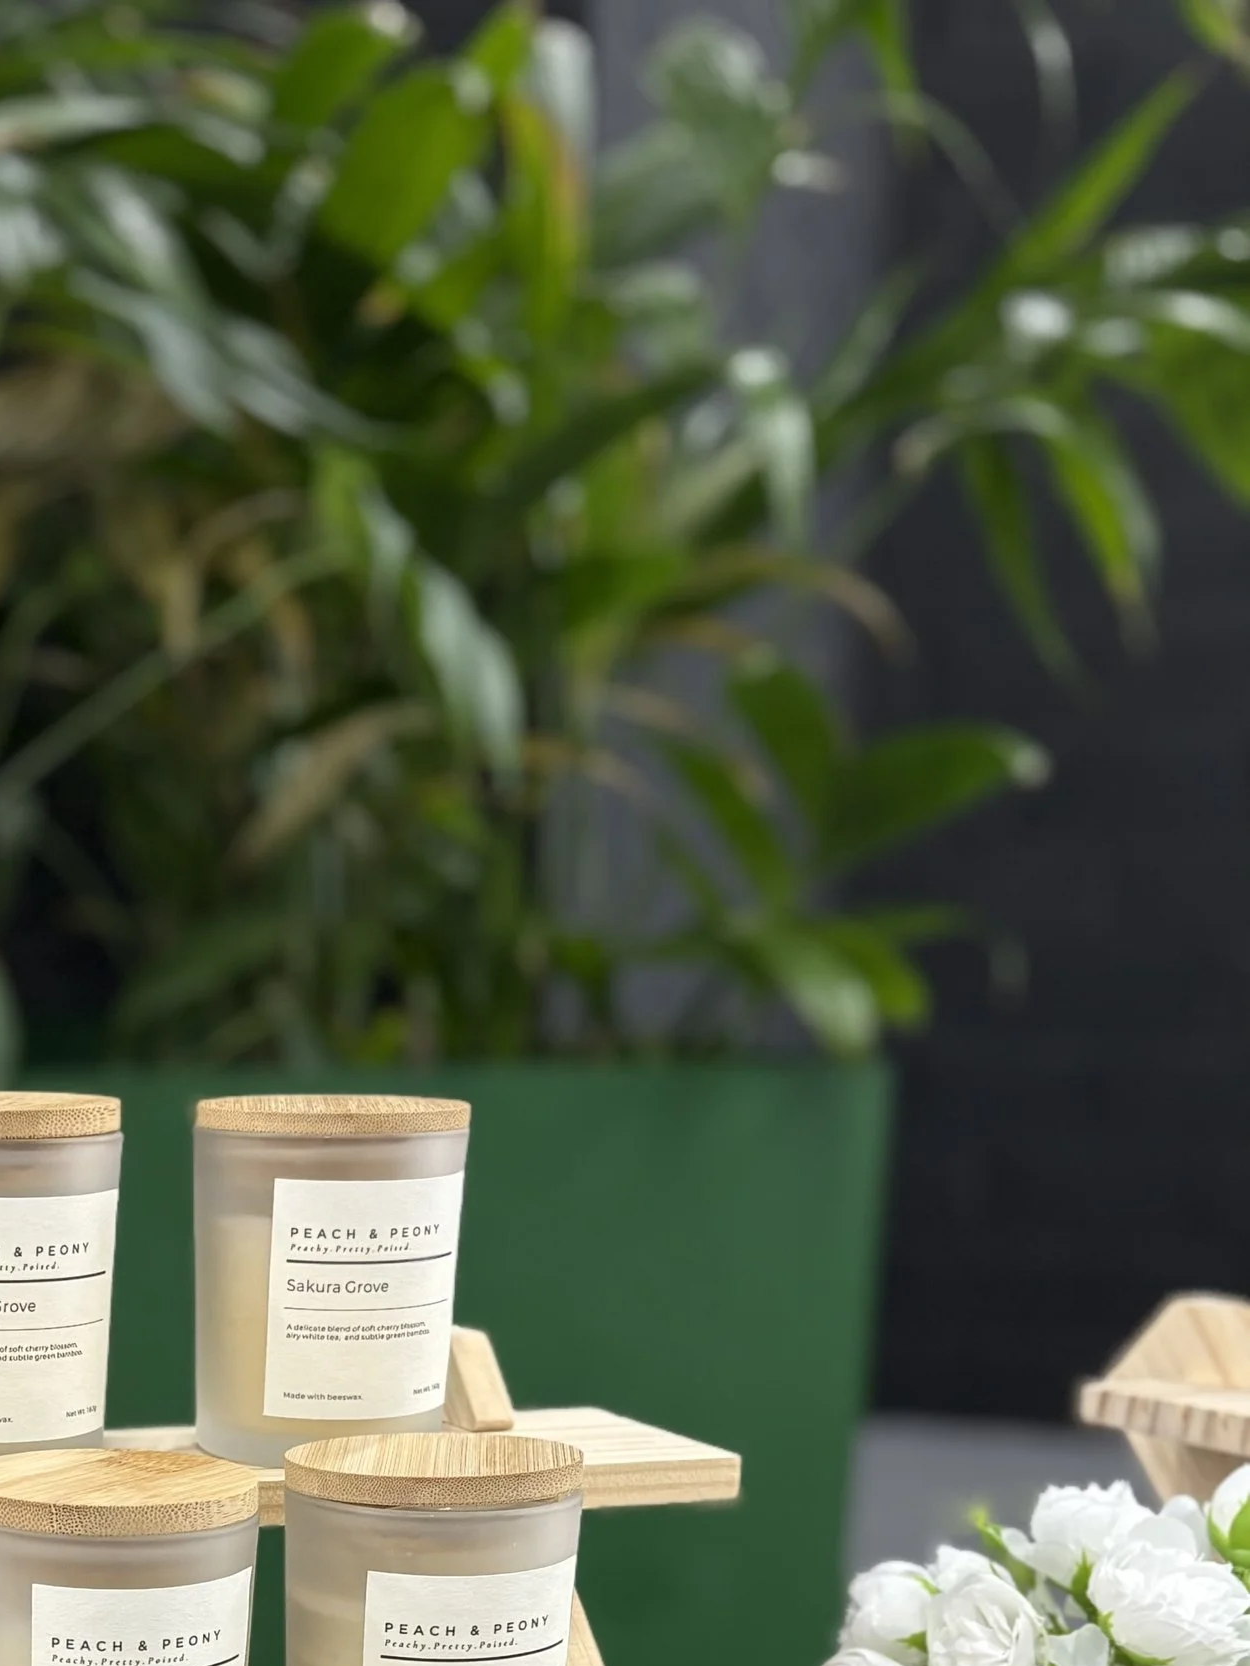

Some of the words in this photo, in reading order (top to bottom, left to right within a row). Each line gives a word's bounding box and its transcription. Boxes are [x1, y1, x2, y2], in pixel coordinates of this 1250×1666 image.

[291, 1228, 356, 1239] PEACH
[369, 1229, 378, 1239] &
[390, 1224, 439, 1238] PEONY
[14, 1247, 22, 1257] &
[36, 1242, 89, 1256] PEONY
[287, 1279, 341, 1293] Sakura
[345, 1281, 389, 1293] Grove
[294, 1324, 326, 1332] delicate
[377, 1324, 399, 1332] cherry
[283, 1392, 305, 1400] Made
[385, 1623, 456, 1636] PEACH
[470, 1626, 479, 1636] &
[494, 1614, 549, 1634] PEONY
[51, 1638, 123, 1651] PEACH
[138, 1641, 147, 1651] &
[163, 1629, 221, 1649] PEONY
